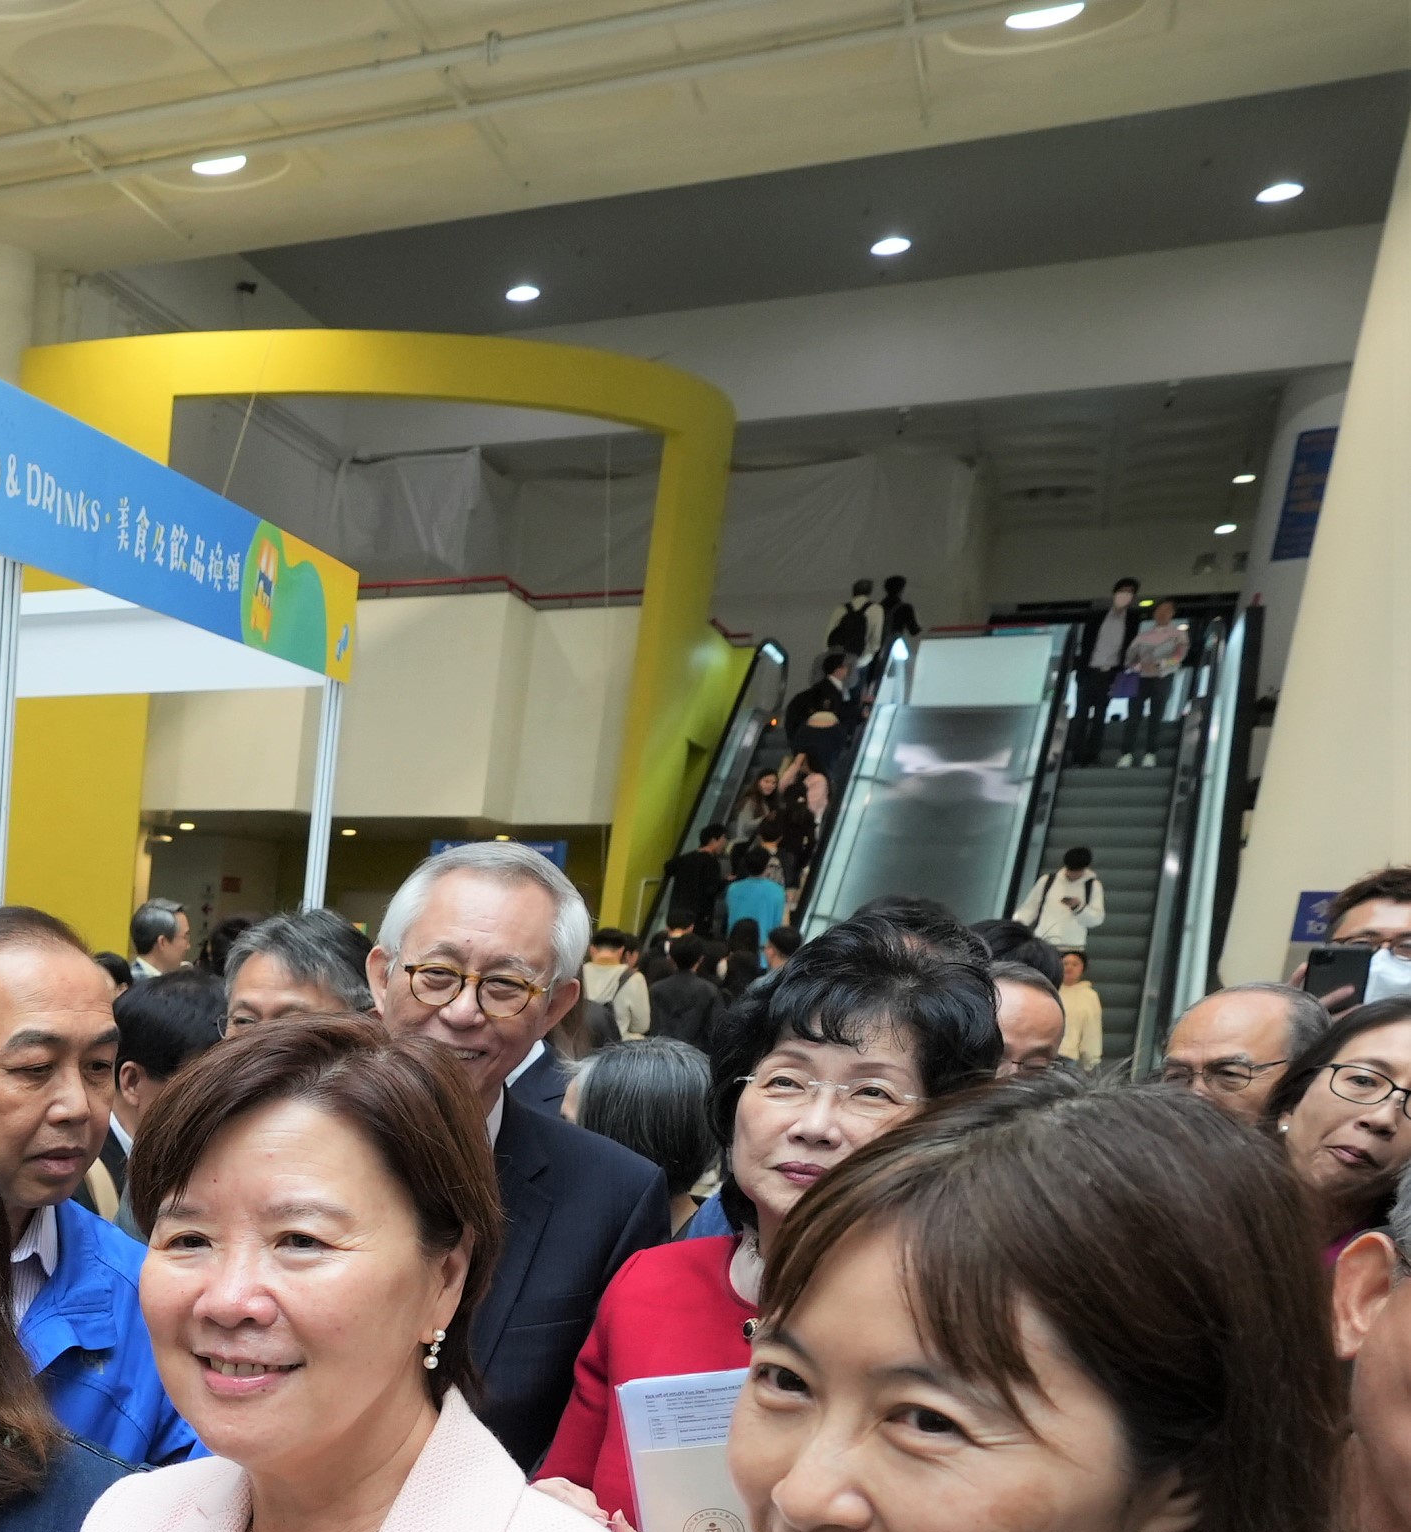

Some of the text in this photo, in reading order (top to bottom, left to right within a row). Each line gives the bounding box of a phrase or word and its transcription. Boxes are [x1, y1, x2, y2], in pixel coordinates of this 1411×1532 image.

[5, 455, 22, 499] &
[26, 462, 101, 533] DRINKS
[116, 497, 241, 592] 美食及飲品換領
